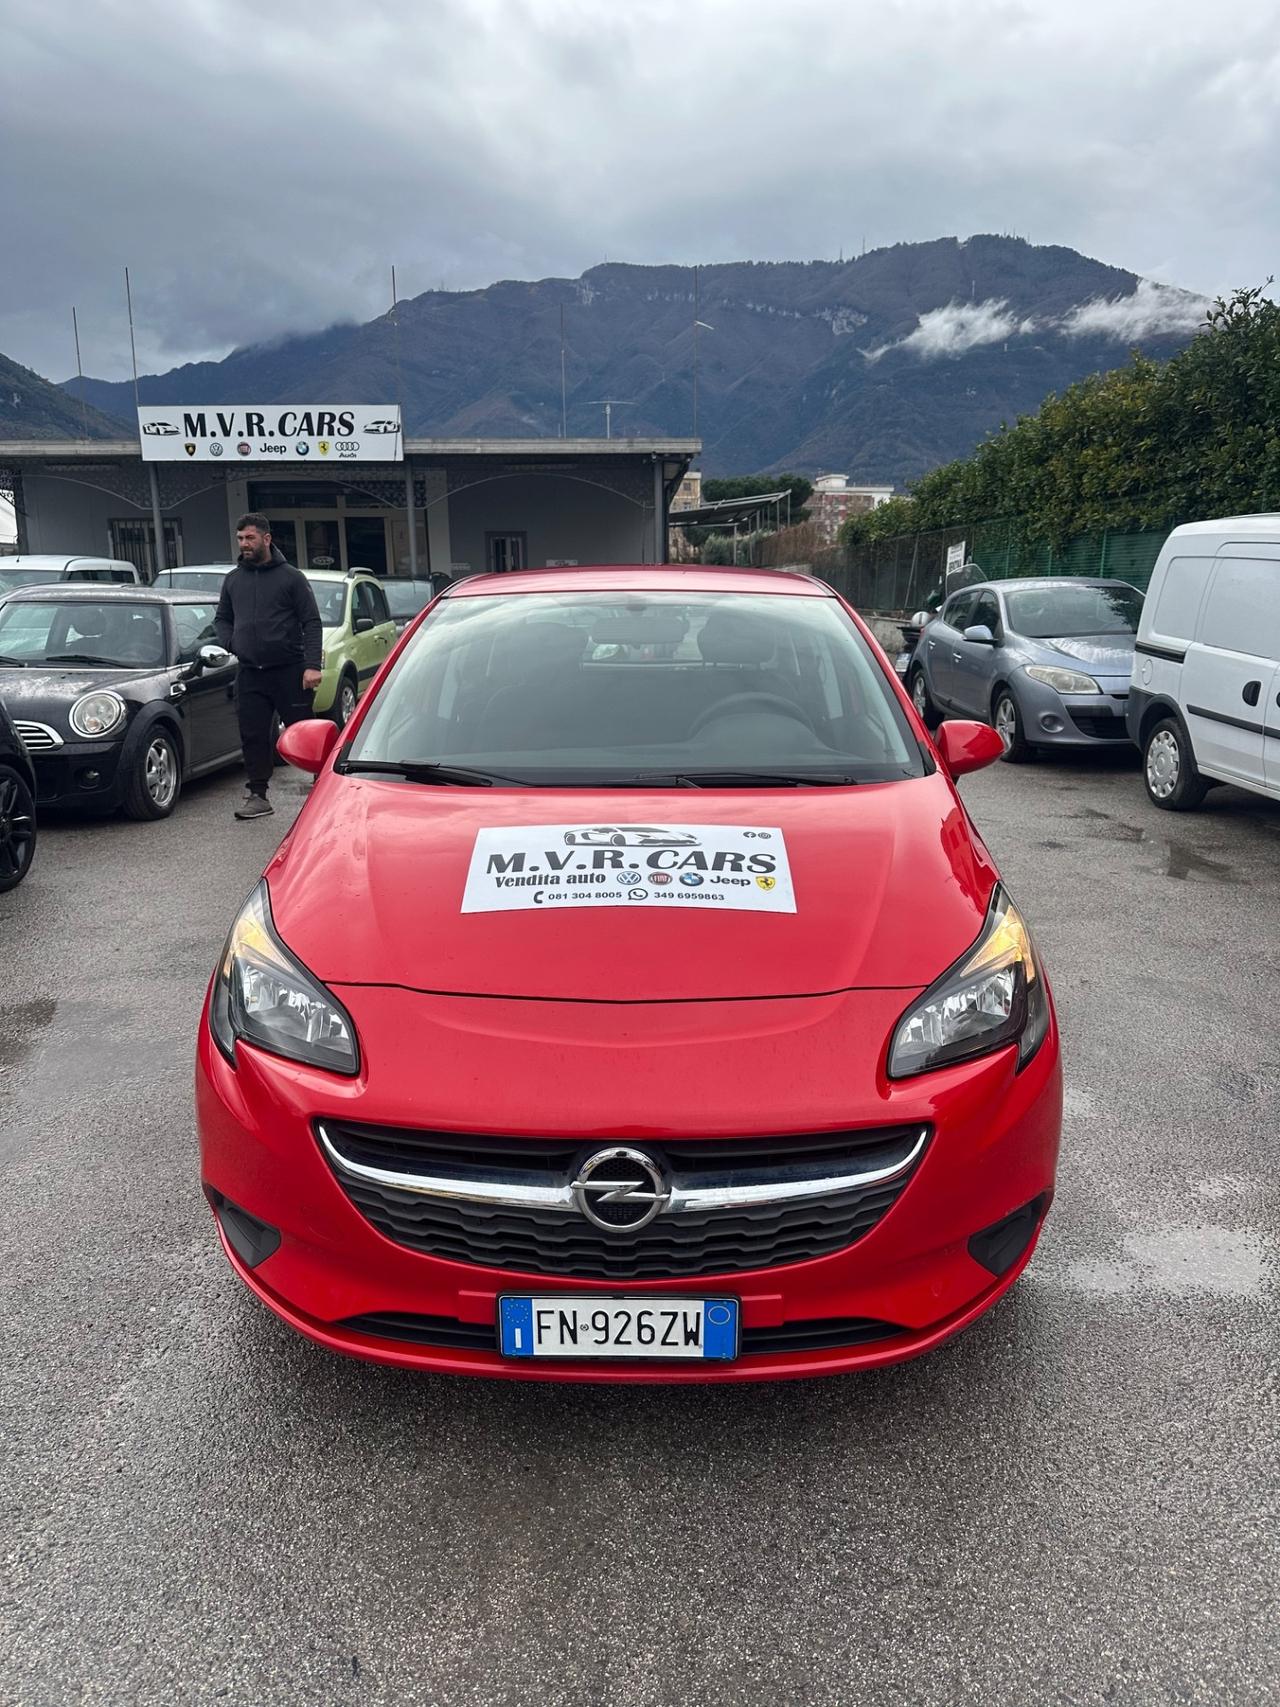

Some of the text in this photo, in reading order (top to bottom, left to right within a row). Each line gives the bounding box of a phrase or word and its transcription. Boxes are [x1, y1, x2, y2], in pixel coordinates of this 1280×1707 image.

[260, 443, 287, 455] Jeep
[495, 872, 561, 888] Vendita
[566, 872, 606, 885] auto
[710, 875, 751, 887] Jeep
[548, 892, 568, 900] 081
[595, 891, 622, 899] 8005
[654, 891, 675, 899] 349
[677, 892, 725, 901] 6959863
